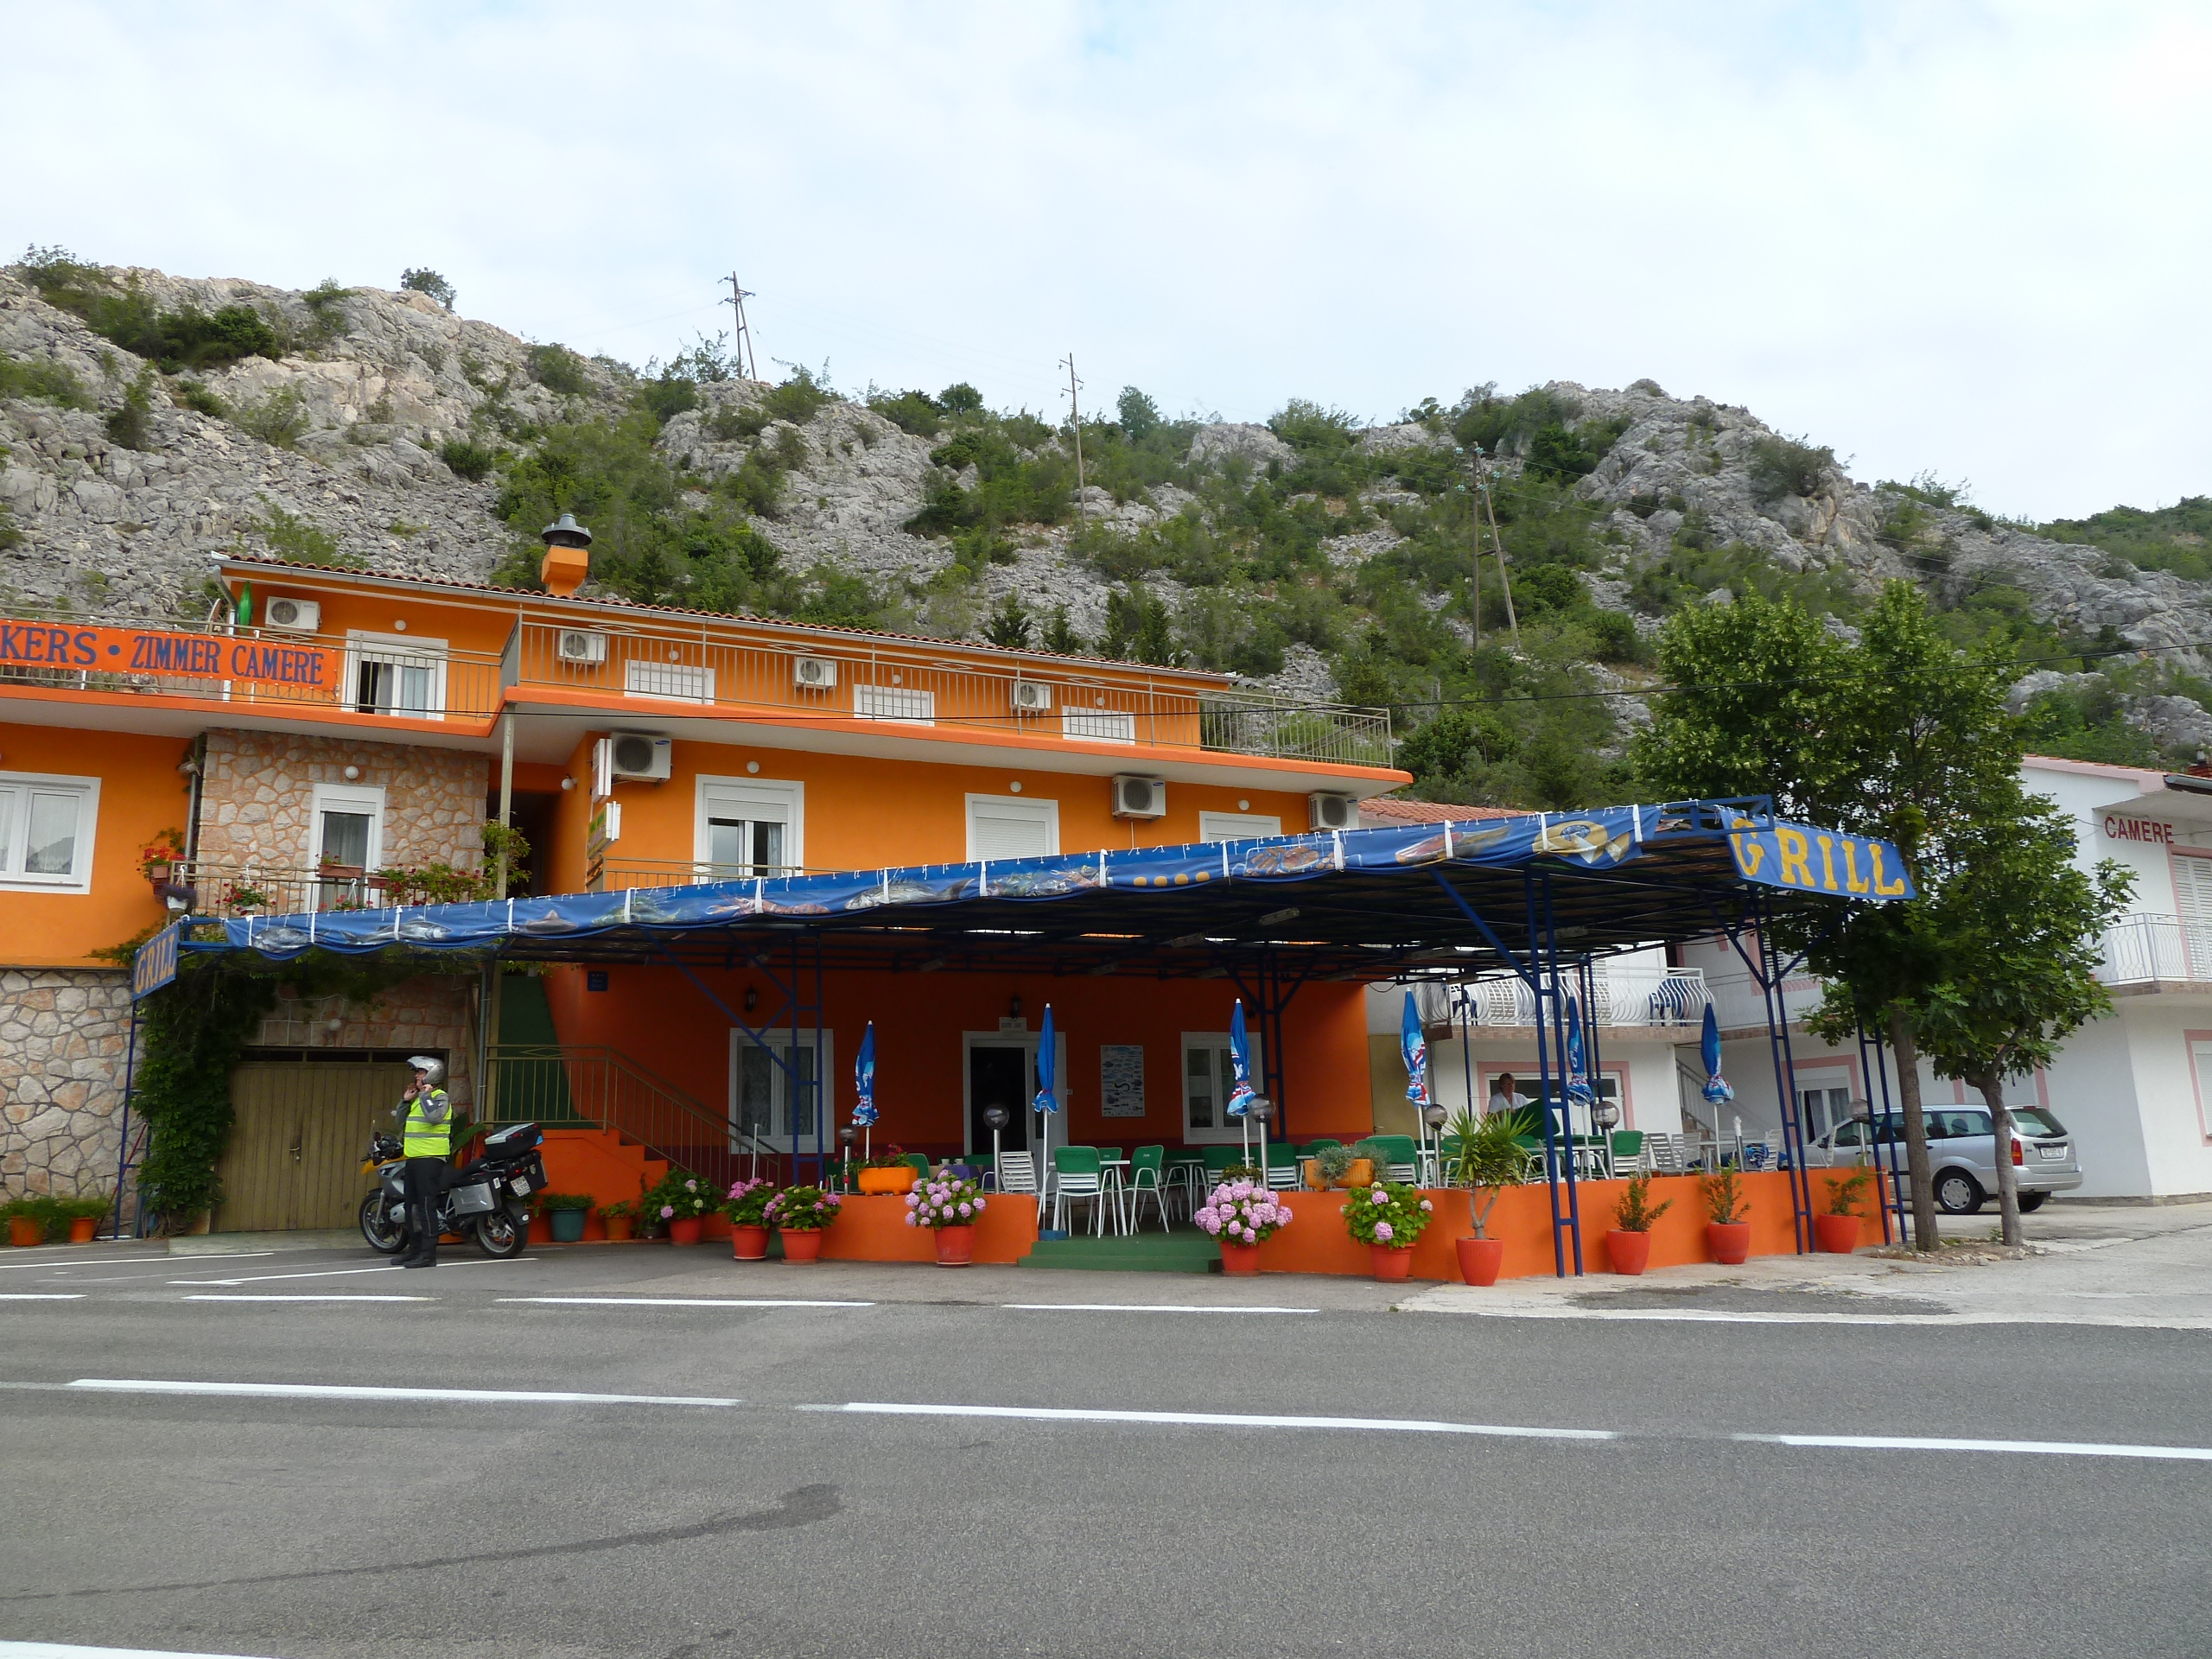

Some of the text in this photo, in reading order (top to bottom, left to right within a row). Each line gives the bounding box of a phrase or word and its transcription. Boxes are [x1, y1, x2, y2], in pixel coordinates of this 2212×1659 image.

[130, 636, 221, 673] ZIMMER
[232, 645, 324, 685] CAMERE
[1732, 817, 1905, 896] GRILL
[2104, 816, 2175, 844] CAMERE
[136, 933, 176, 995] GRILL
